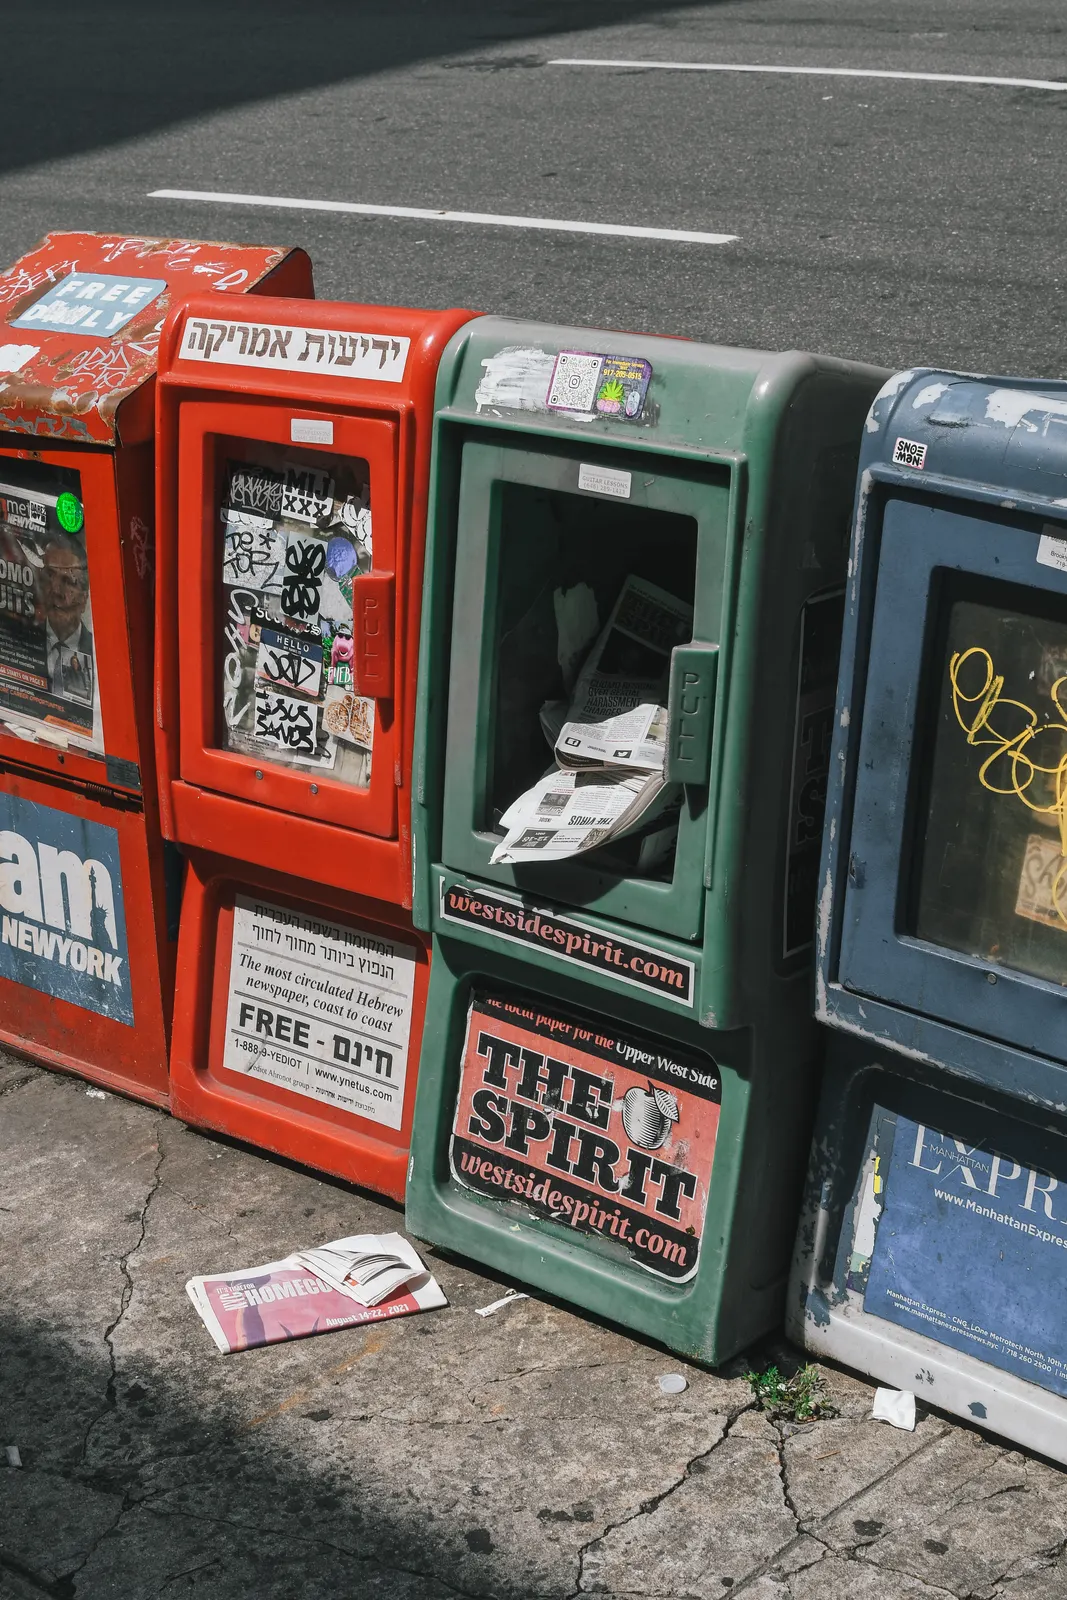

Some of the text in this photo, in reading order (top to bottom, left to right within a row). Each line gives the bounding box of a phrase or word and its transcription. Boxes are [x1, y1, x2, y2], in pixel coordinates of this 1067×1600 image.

[55, 281, 153, 304] FREE
[187, 321, 401, 370] ידיעות אמריקה
[283, 495, 327, 519] XXX
[276, 635, 310, 653] HELLO
[365, 598, 380, 678] PULL
[587, 696, 642, 708] HARASSMENT
[677, 671, 700, 762] PULL
[568, 815, 597, 826] VIRUS
[0, 830, 118, 950] am
[2, 914, 122, 986] NEWYORK
[252, 923, 395, 981] הנפוץ ביותר מחוף לחוף
[253, 903, 395, 959] המקומון בשפה העברית
[449, 893, 685, 989] westsidespirit.com
[239, 953, 404, 1018] The most circulated Hebrew
[246, 975, 394, 1033] newspaper, coast to coast
[234, 1038, 302, 1070] 1-888-9-YEDIOT
[315, 1066, 393, 1103] www.ynetus.com
[239, 1002, 311, 1049] FREE
[332, 1033, 394, 1078] חינם
[535, 1014, 573, 1034] paper
[615, 1039, 655, 1065] Upper
[656, 1055, 690, 1079] West
[688, 1067, 718, 1090] Side
[252, 1064, 268, 1075] ediot
[293, 1079, 310, 1092] group
[476, 1031, 615, 1132] THE
[467, 1087, 698, 1223] SPIRIT
[907, 1123, 1067, 1225] EXPR
[929, 1143, 990, 1174] MANHATTAN
[460, 1151, 687, 1267] westsidespirit.com
[219, 1291, 249, 1312] NYC
[325, 1304, 409, 1328] August 14-22, 2021
[886, 1289, 920, 1307] Manhattan
[921, 1303, 947, 1319] Express
[990, 1332, 1023, 1351] Metrotech
[1024, 1347, 1046, 1361] North,
[1047, 1356, 1062, 1368] 10th
[893, 1301, 999, 1350] www.manhattanexpressnews.nyc
[1006, 1348, 1018, 1357] 718
[1018, 1353, 1032, 1364] 260
[1033, 1360, 1052, 1372] 2500
